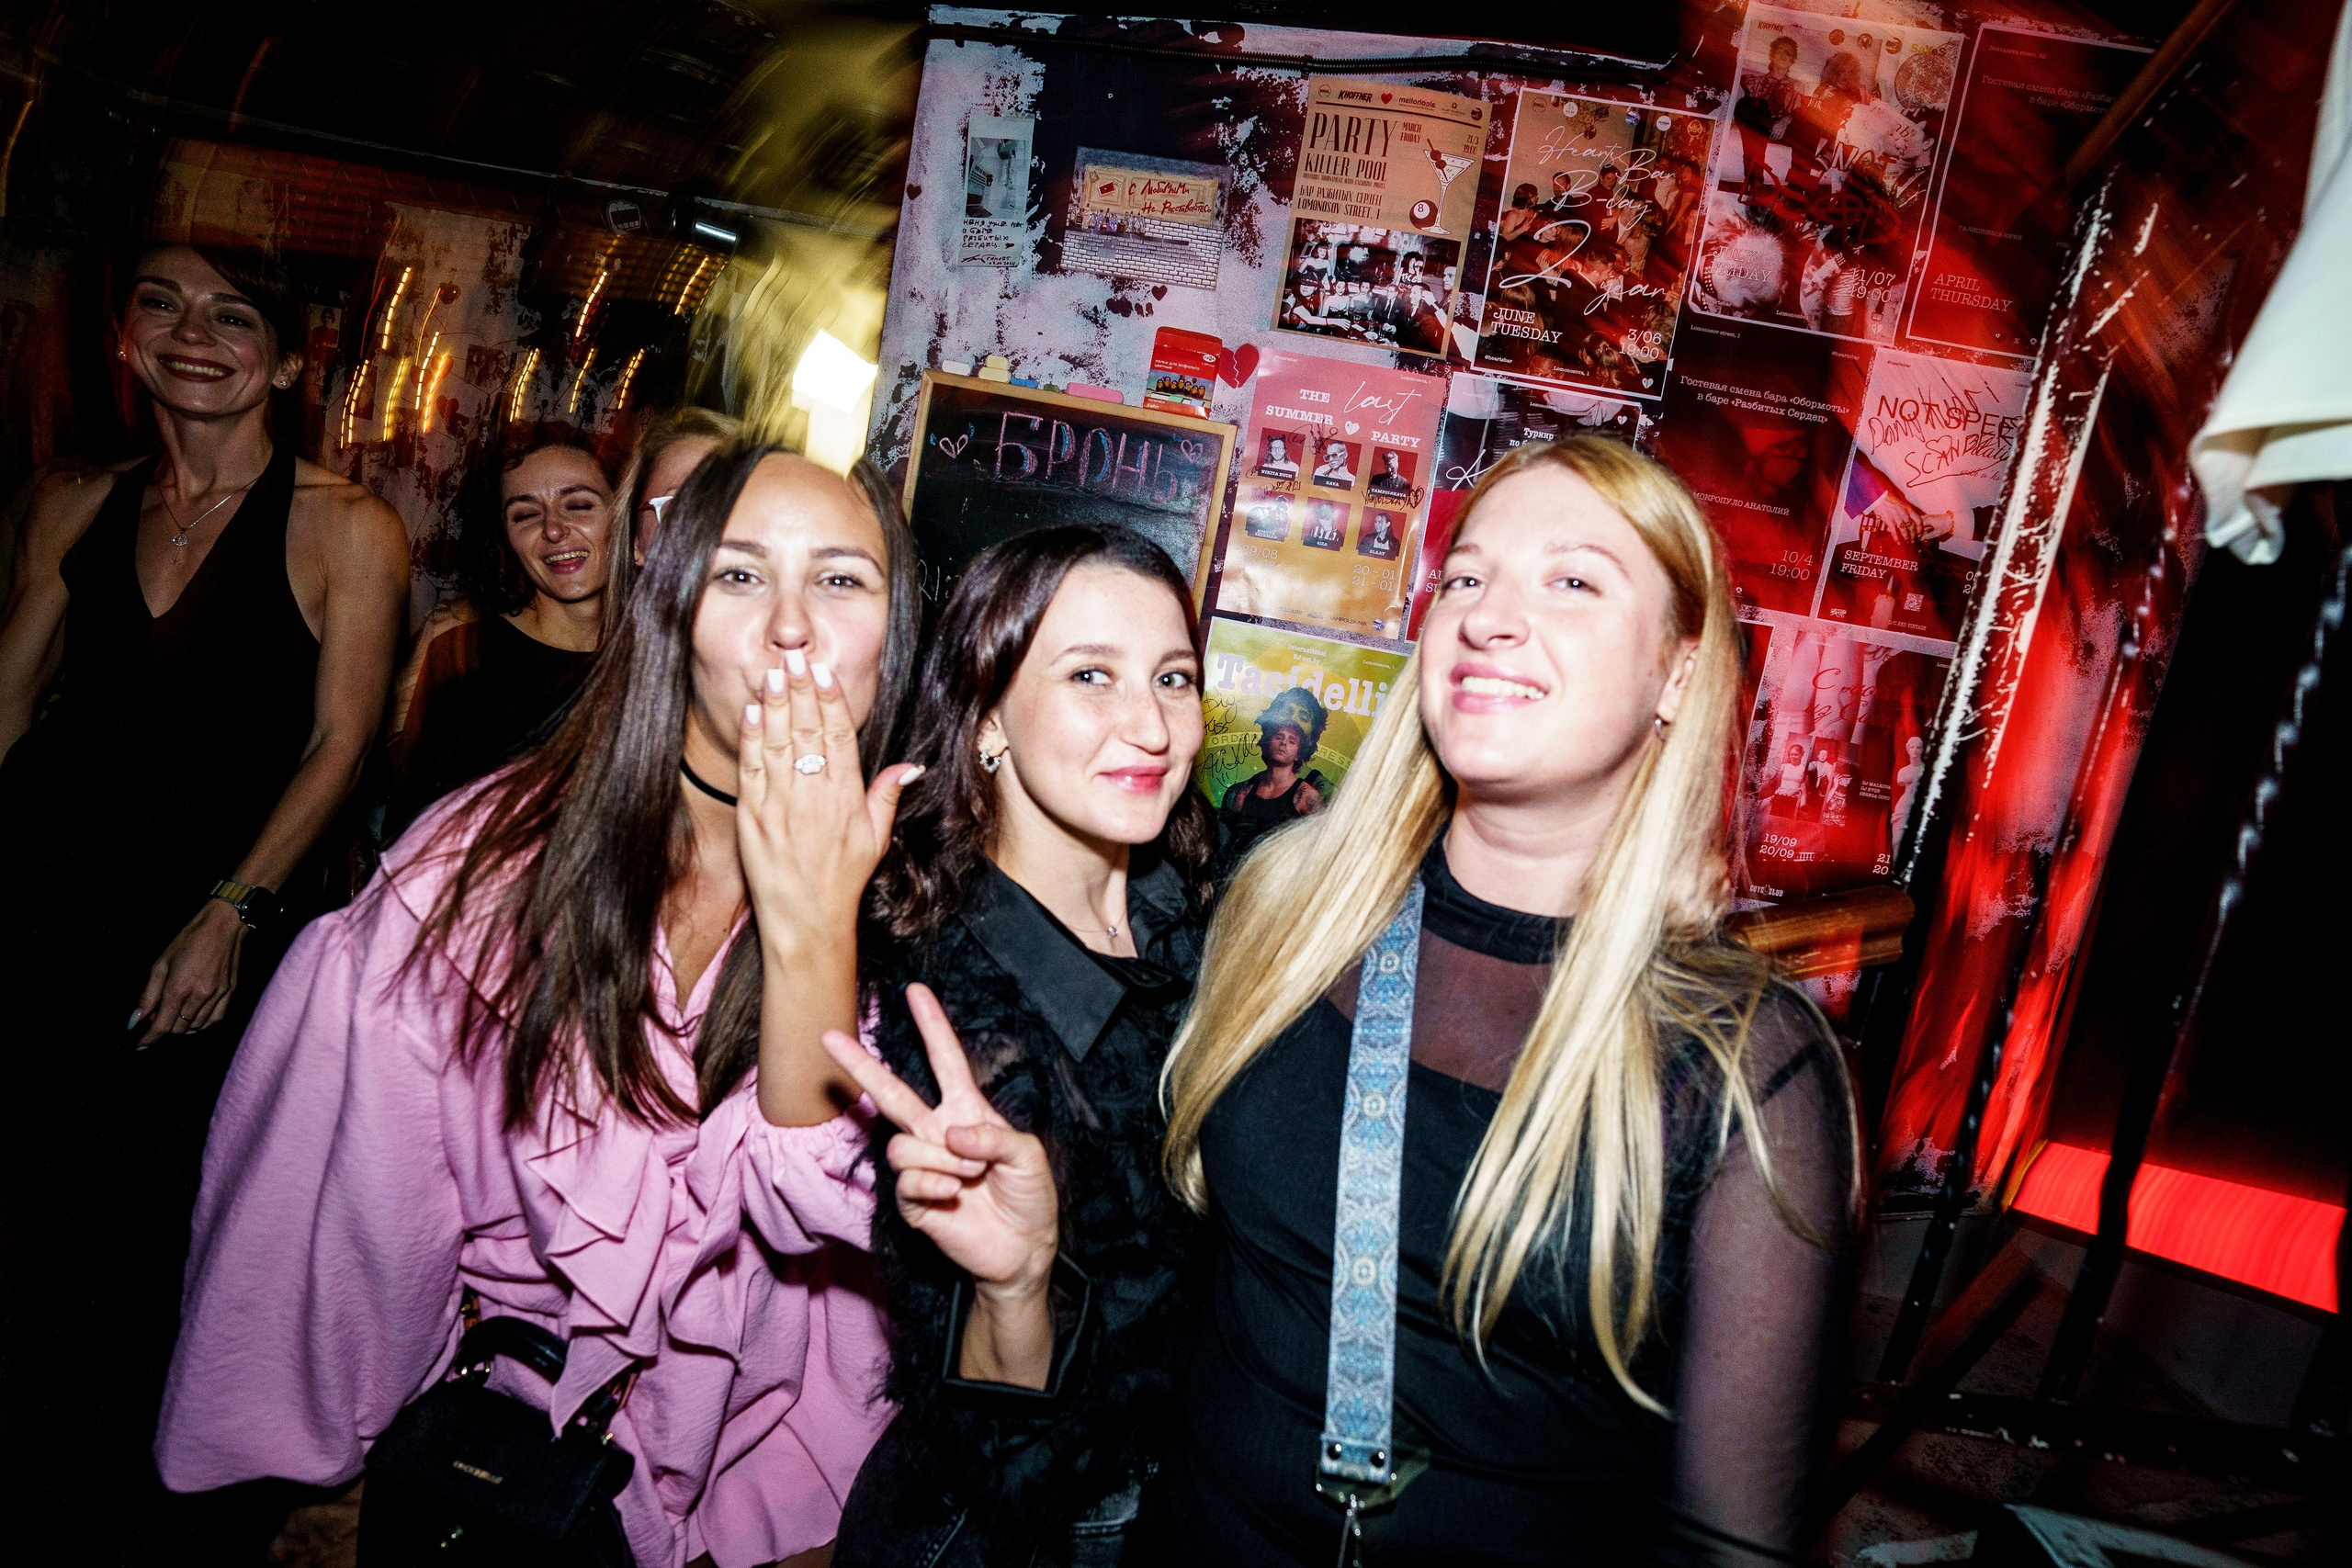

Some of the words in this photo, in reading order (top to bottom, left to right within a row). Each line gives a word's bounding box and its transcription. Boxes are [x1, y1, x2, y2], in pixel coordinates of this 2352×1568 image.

[1981, 74, 2025, 90] Гостевая
[2026, 82, 2056, 95] смена
[2057, 85, 2079, 99] бара
[2029, 96, 2036, 104] в
[2037, 95, 2059, 108] баре
[1308, 111, 1398, 158] PARTY
[1402, 121, 1422, 133] MARCH
[1400, 131, 1421, 144] FRIDAY
[1538, 125, 1623, 168] Hearts
[1304, 152, 1351, 177] KILLER
[1355, 158, 1388, 182] POOL
[1615, 148, 1678, 185] Bar
[1300, 185, 1314, 197] БАР
[1317, 186, 1354, 202] РАЗБИТЫХ
[1551, 169, 1653, 231] B-day
[1297, 197, 1341, 214] LOMONOSOV
[1417, 203, 1425, 213] 8
[1498, 219, 1592, 289] 2
[1713, 245, 1756, 264] JULY
[1709, 261, 1773, 283] FRIDAY
[1934, 273, 1980, 292] APRIL
[1848, 284, 1892, 303] 19:00
[1930, 288, 2013, 312] THURSDAY
[1493, 307, 1536, 324] JUNE
[1489, 321, 1564, 344] TUESDAY
[1627, 329, 1662, 345] 3/06
[1690, 324, 1719, 334] Lomonosov
[1485, 355, 1513, 364] @heartsbar
[1618, 343, 1660, 360] 19:00
[1300, 389, 1331, 403] THE
[1680, 375, 1728, 392] Гостевая
[1729, 385, 1762, 399] смена
[1763, 390, 1788, 403] бара
[1790, 396, 1850, 414] «Обормоты»
[1697, 393, 1705, 401] в
[1705, 392, 1729, 405] баре
[1731, 398, 1786, 416] «Разбитых
[1787, 409, 1829, 424] Сердец»
[1265, 404, 1335, 426] SUMMER
[1371, 430, 1421, 448] PARTY
[1523, 427, 1555, 441] Турнир
[1509, 439, 1521, 447] по
[994, 411, 1179, 504] БРОНЬ
[1744, 502, 1791, 516] АНАТОЛИЙ
[1781, 550, 1814, 567] 10/4
[1844, 549, 1919, 571] SEPTEMBER
[1353, 564, 1370, 576] 20
[1381, 569, 1396, 581] 01
[1770, 563, 1810, 581] 19:00
[1840, 563, 1887, 580] FRIDAY
[1351, 576, 1367, 587] 21
[1379, 581, 1394, 592] 01
[1288, 644, 1327, 657] International
[1216, 653, 1388, 716] Tacidelli
[1763, 832, 1798, 847] 19/09
[1759, 844, 1795, 859] 20/09
[1877, 852, 1891, 864] 21
[1872, 864, 1889, 875] 20
